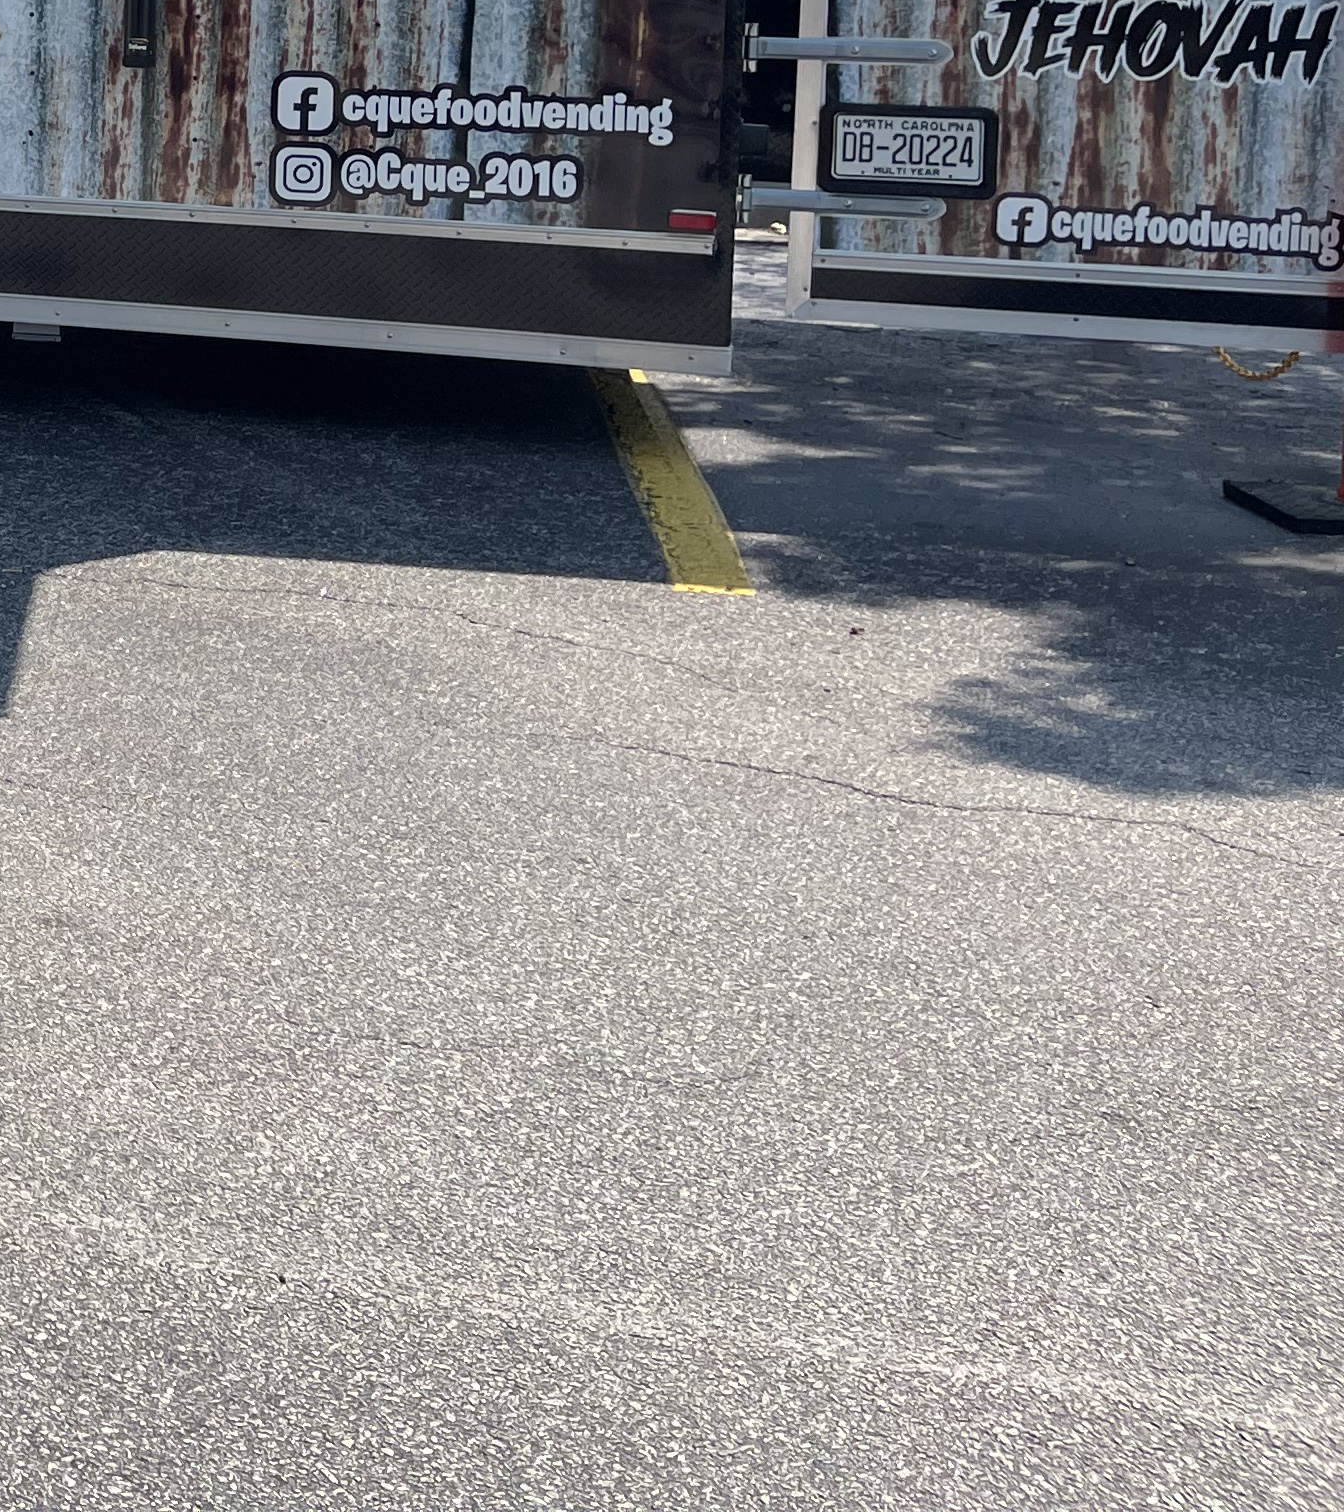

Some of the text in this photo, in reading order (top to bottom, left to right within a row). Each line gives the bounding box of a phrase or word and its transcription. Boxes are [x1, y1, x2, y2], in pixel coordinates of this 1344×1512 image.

[342, 90, 673, 146] cquefoodvending
[842, 119, 975, 132] NORTH CAROLINA
[842, 131, 973, 167] DB-20224
[341, 152, 577, 201] @Cque_2016
[873, 167, 940, 176] MULTI YEAR
[1051, 206, 1341, 267] cquefoodvending
